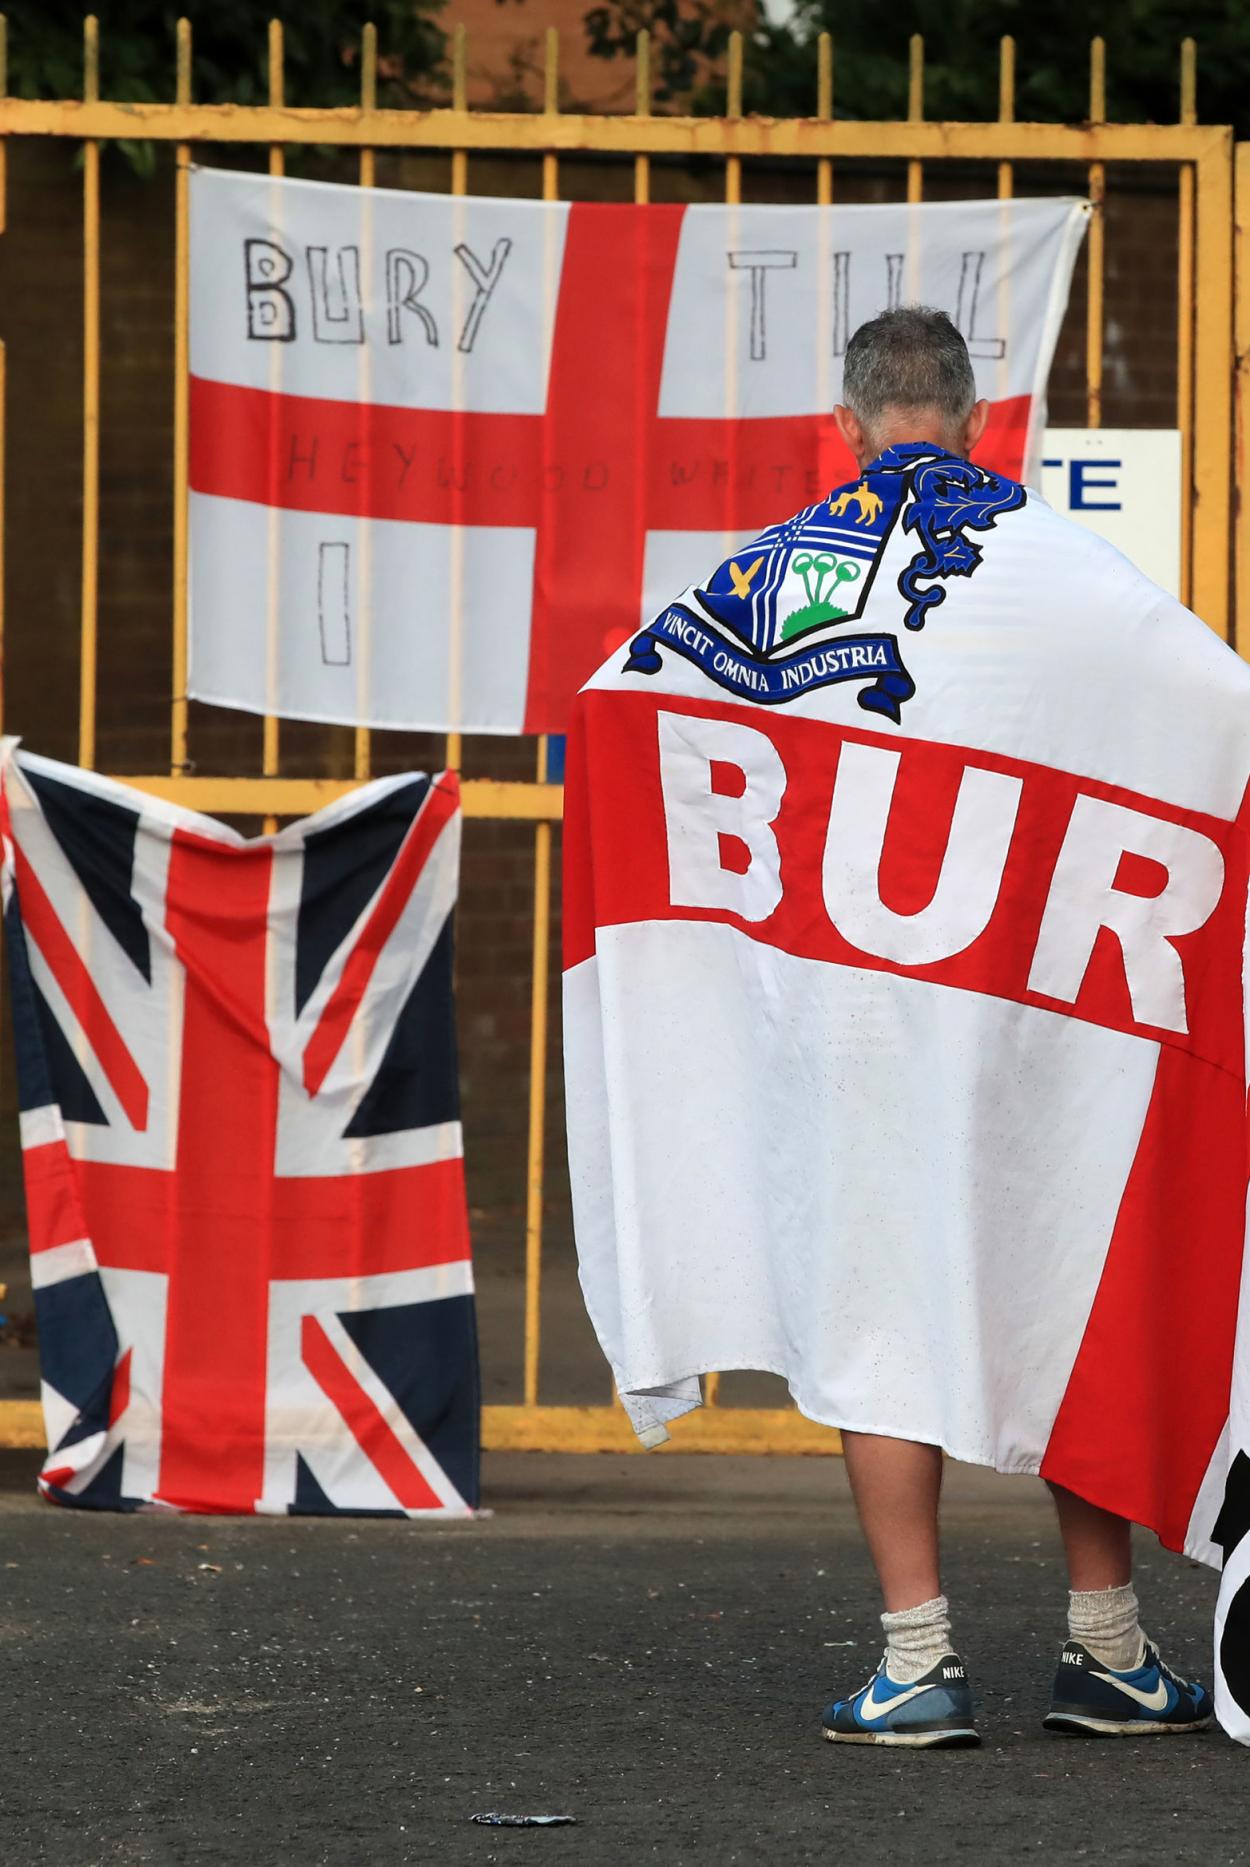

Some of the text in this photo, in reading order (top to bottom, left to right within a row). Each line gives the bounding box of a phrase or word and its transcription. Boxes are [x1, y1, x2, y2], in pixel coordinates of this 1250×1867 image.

[243, 238, 512, 353] BURY
[662, 611, 888, 693] VINCIT OMNIA INDUSTRIA
[942, 1666, 966, 1680] NIKE
[1061, 1651, 1084, 1666] NIKE
